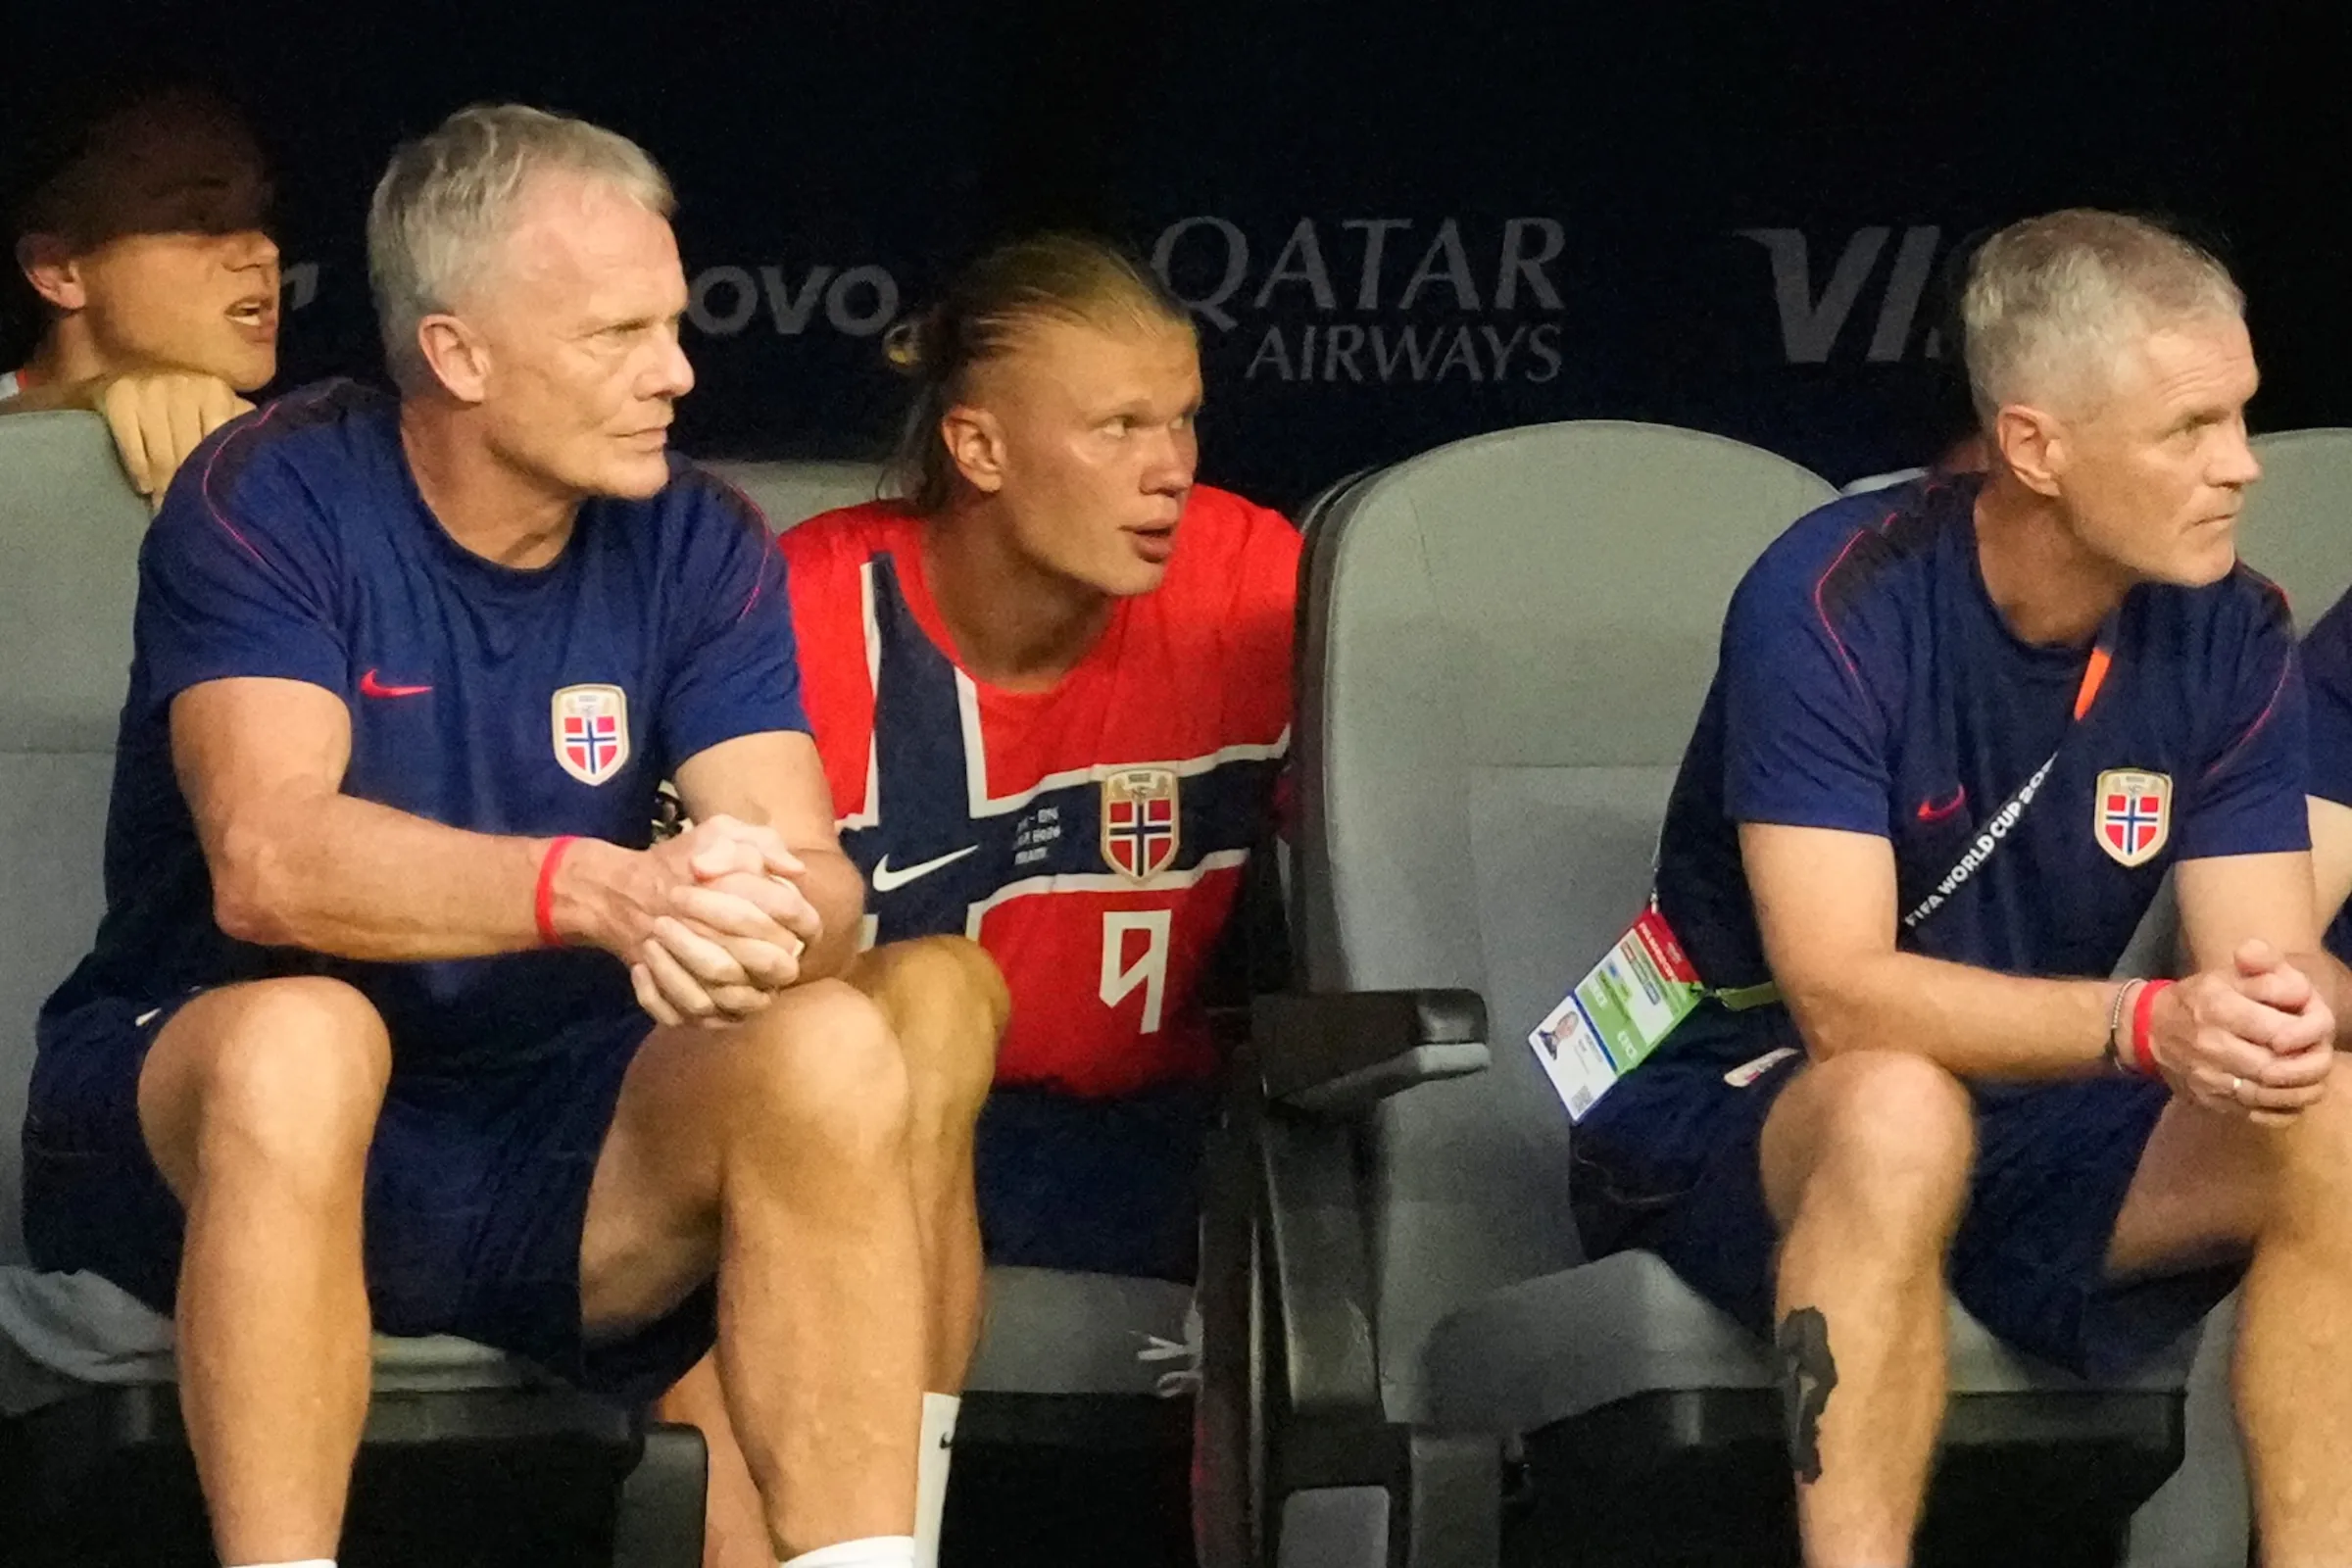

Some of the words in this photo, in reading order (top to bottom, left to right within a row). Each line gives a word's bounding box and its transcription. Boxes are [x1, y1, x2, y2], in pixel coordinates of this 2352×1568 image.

[1150, 216, 1566, 332] QATAR
[1733, 224, 1942, 363] VI
[1244, 322, 1564, 384] AIRWAYS
[1905, 894, 1944, 927] FIFA
[1936, 834, 1995, 895] WORLD
[1989, 802, 2022, 839] CUP
[2019, 751, 2058, 805] 20
[1099, 908, 1172, 1035] 9
